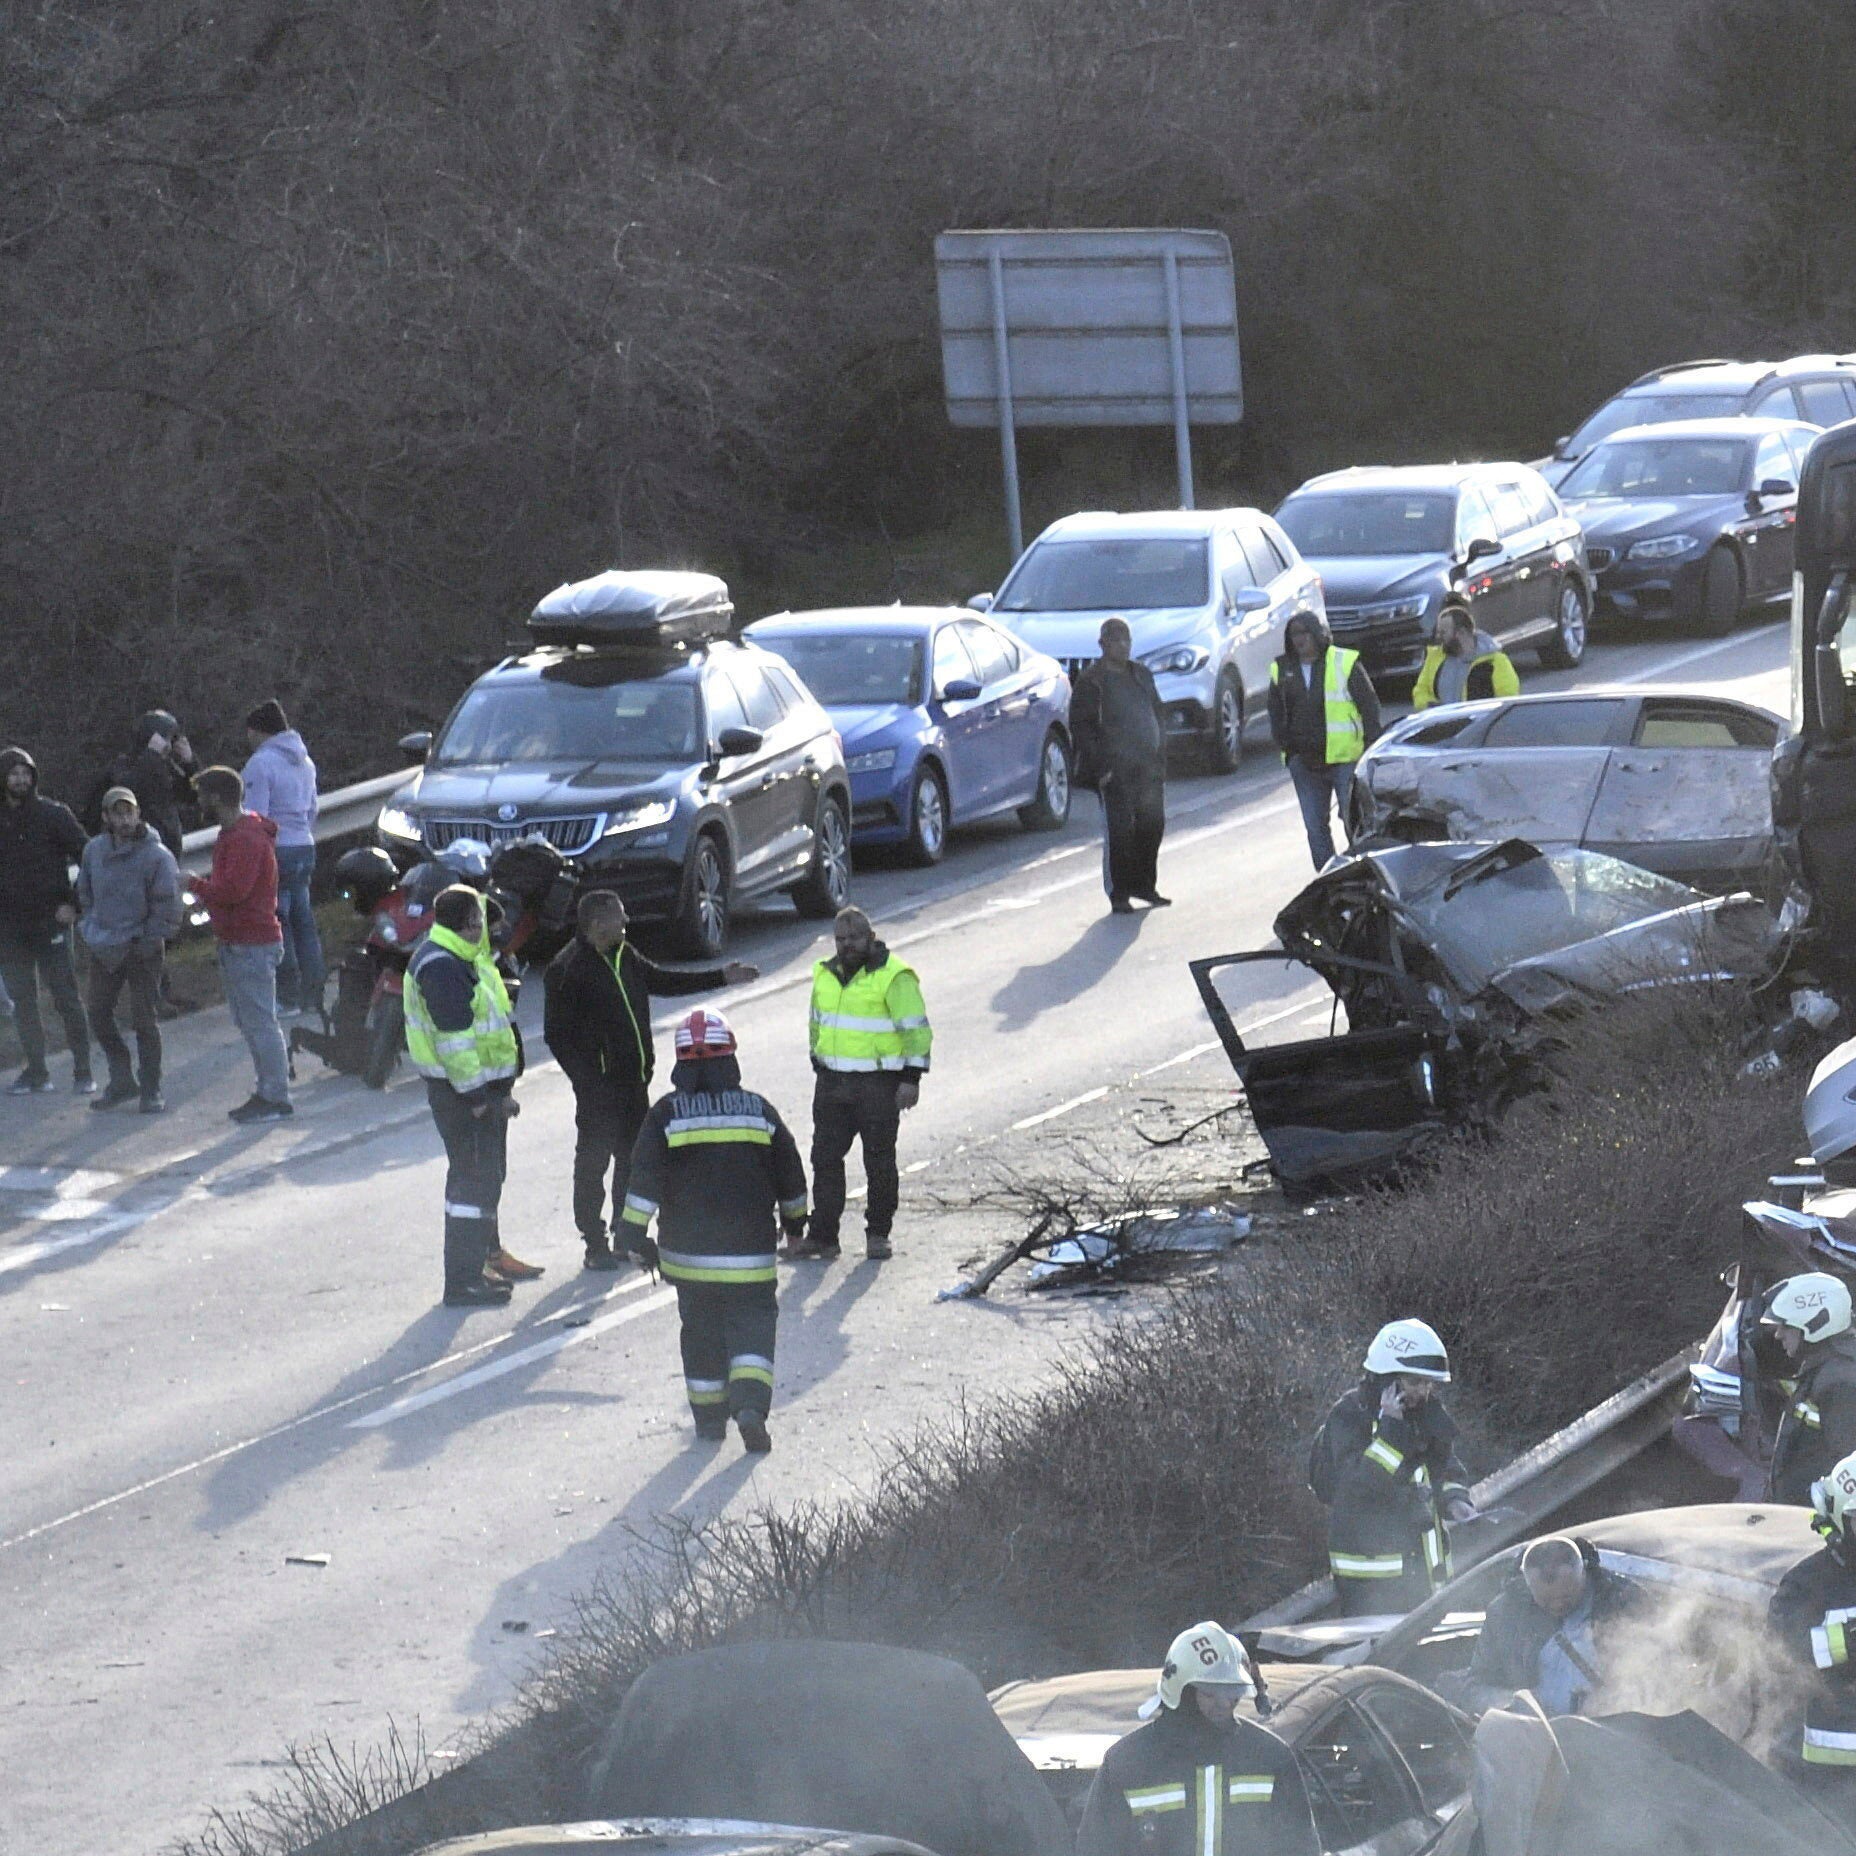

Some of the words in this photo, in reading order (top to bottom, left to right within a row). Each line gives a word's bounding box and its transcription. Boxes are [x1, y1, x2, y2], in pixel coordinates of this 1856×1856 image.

[1794, 1291, 1827, 1309] SZF
[1385, 1334, 1419, 1354] SZF
[1191, 1636, 1219, 1666] EG
